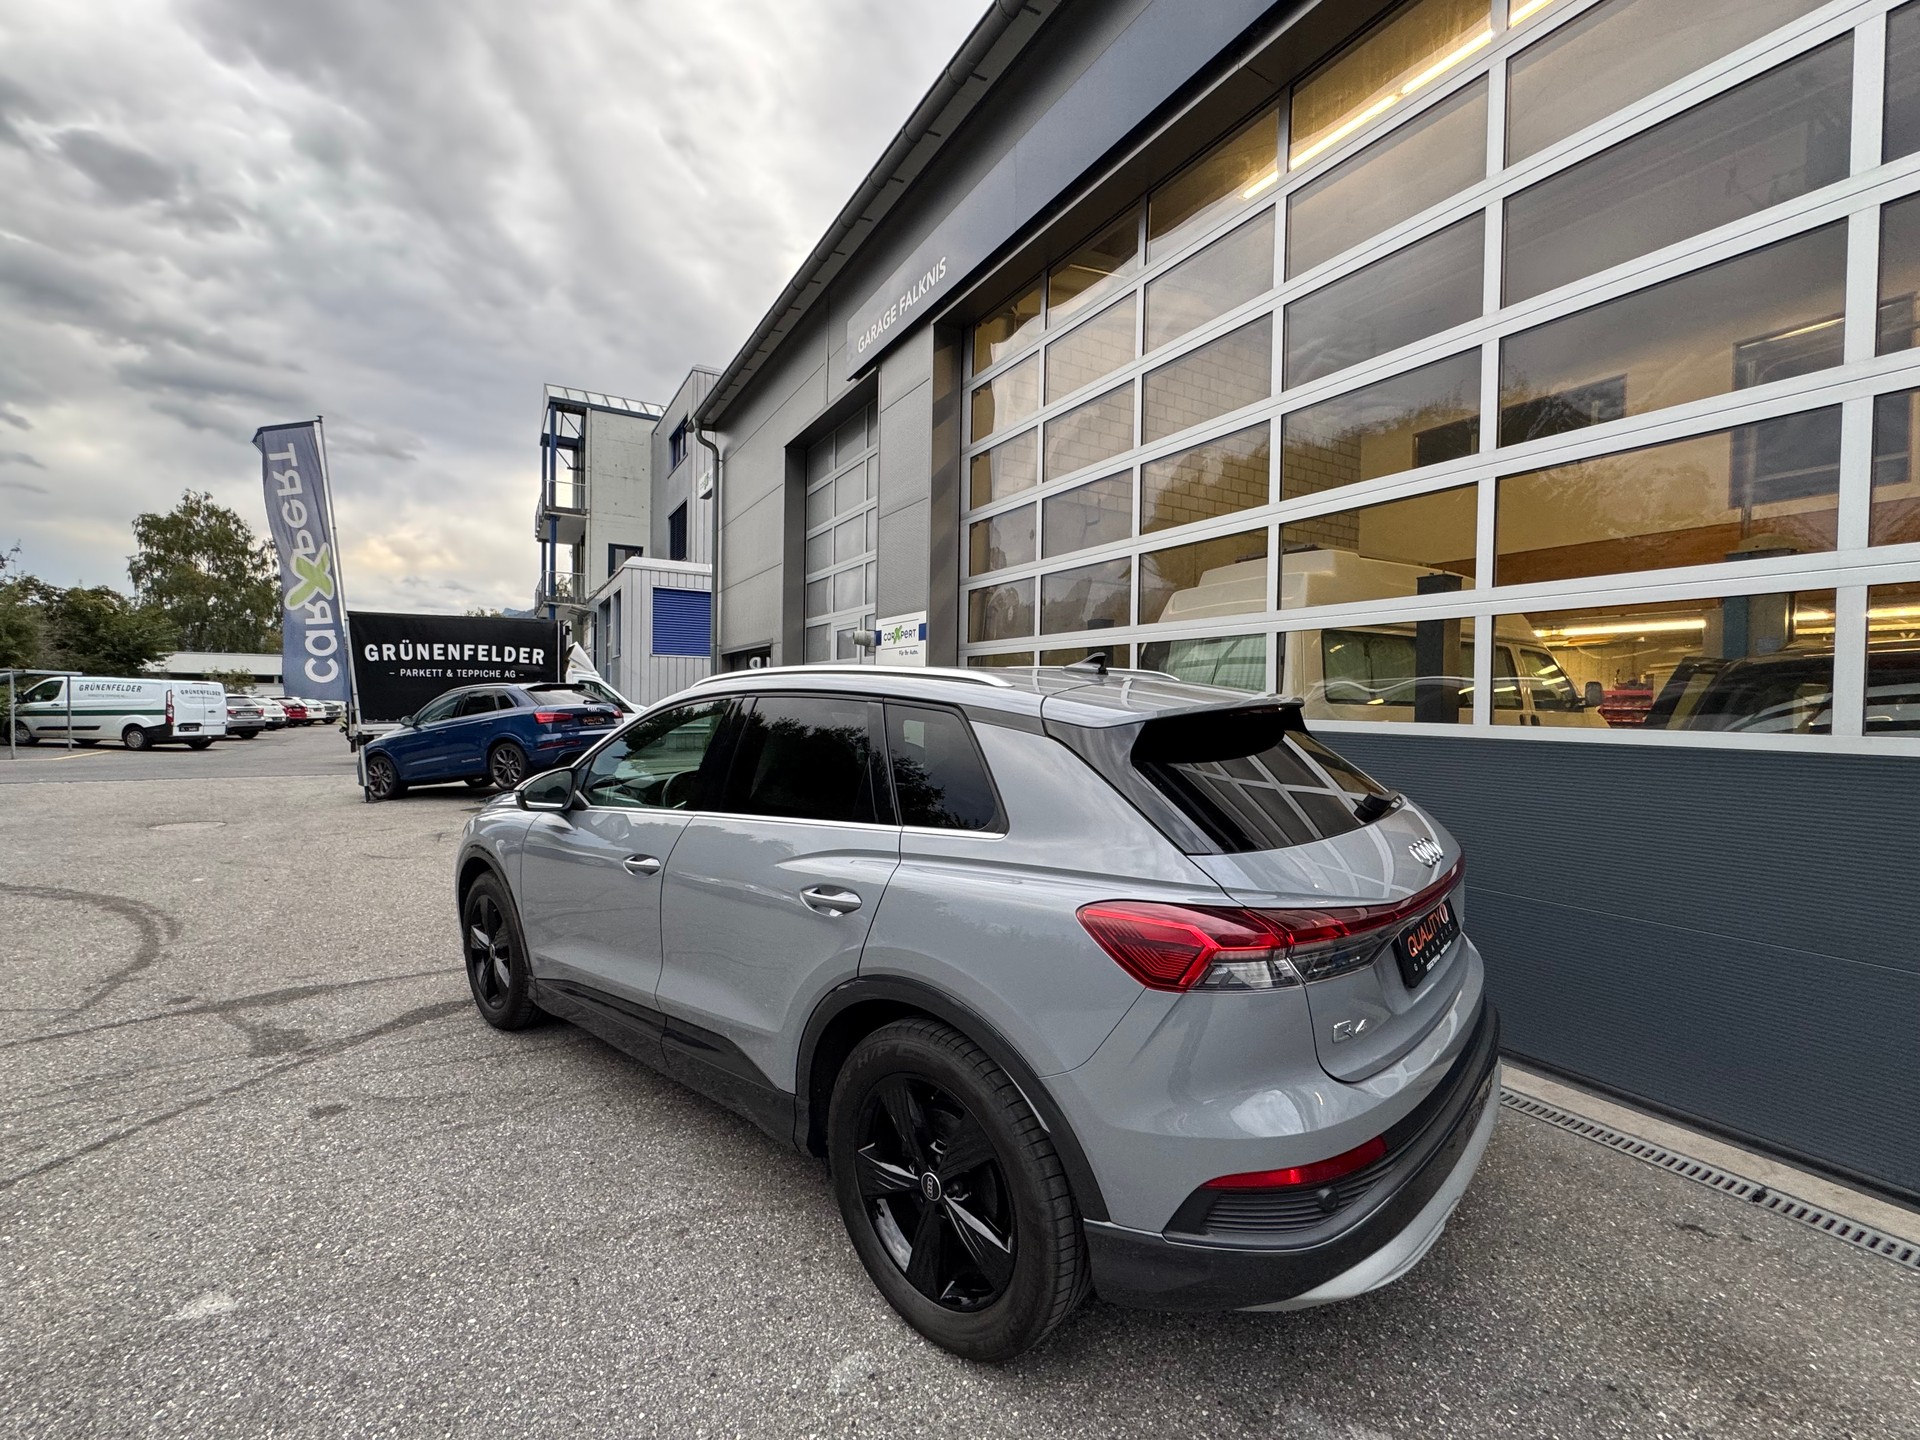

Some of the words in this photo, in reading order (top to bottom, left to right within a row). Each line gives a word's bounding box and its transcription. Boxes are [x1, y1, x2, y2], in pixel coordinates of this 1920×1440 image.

[857, 304, 897, 353] GARAGE
[899, 256, 947, 316] FALKNIS
[364, 639, 545, 665] GRÜNENFELDER
[400, 668, 443, 677] PARKETT
[446, 669, 453, 678] &
[457, 669, 501, 678] TEPPICHE
[504, 670, 516, 678] AG
[79, 682, 142, 692] GRÜNENFELDER
[1407, 908, 1441, 957] QUALITY
